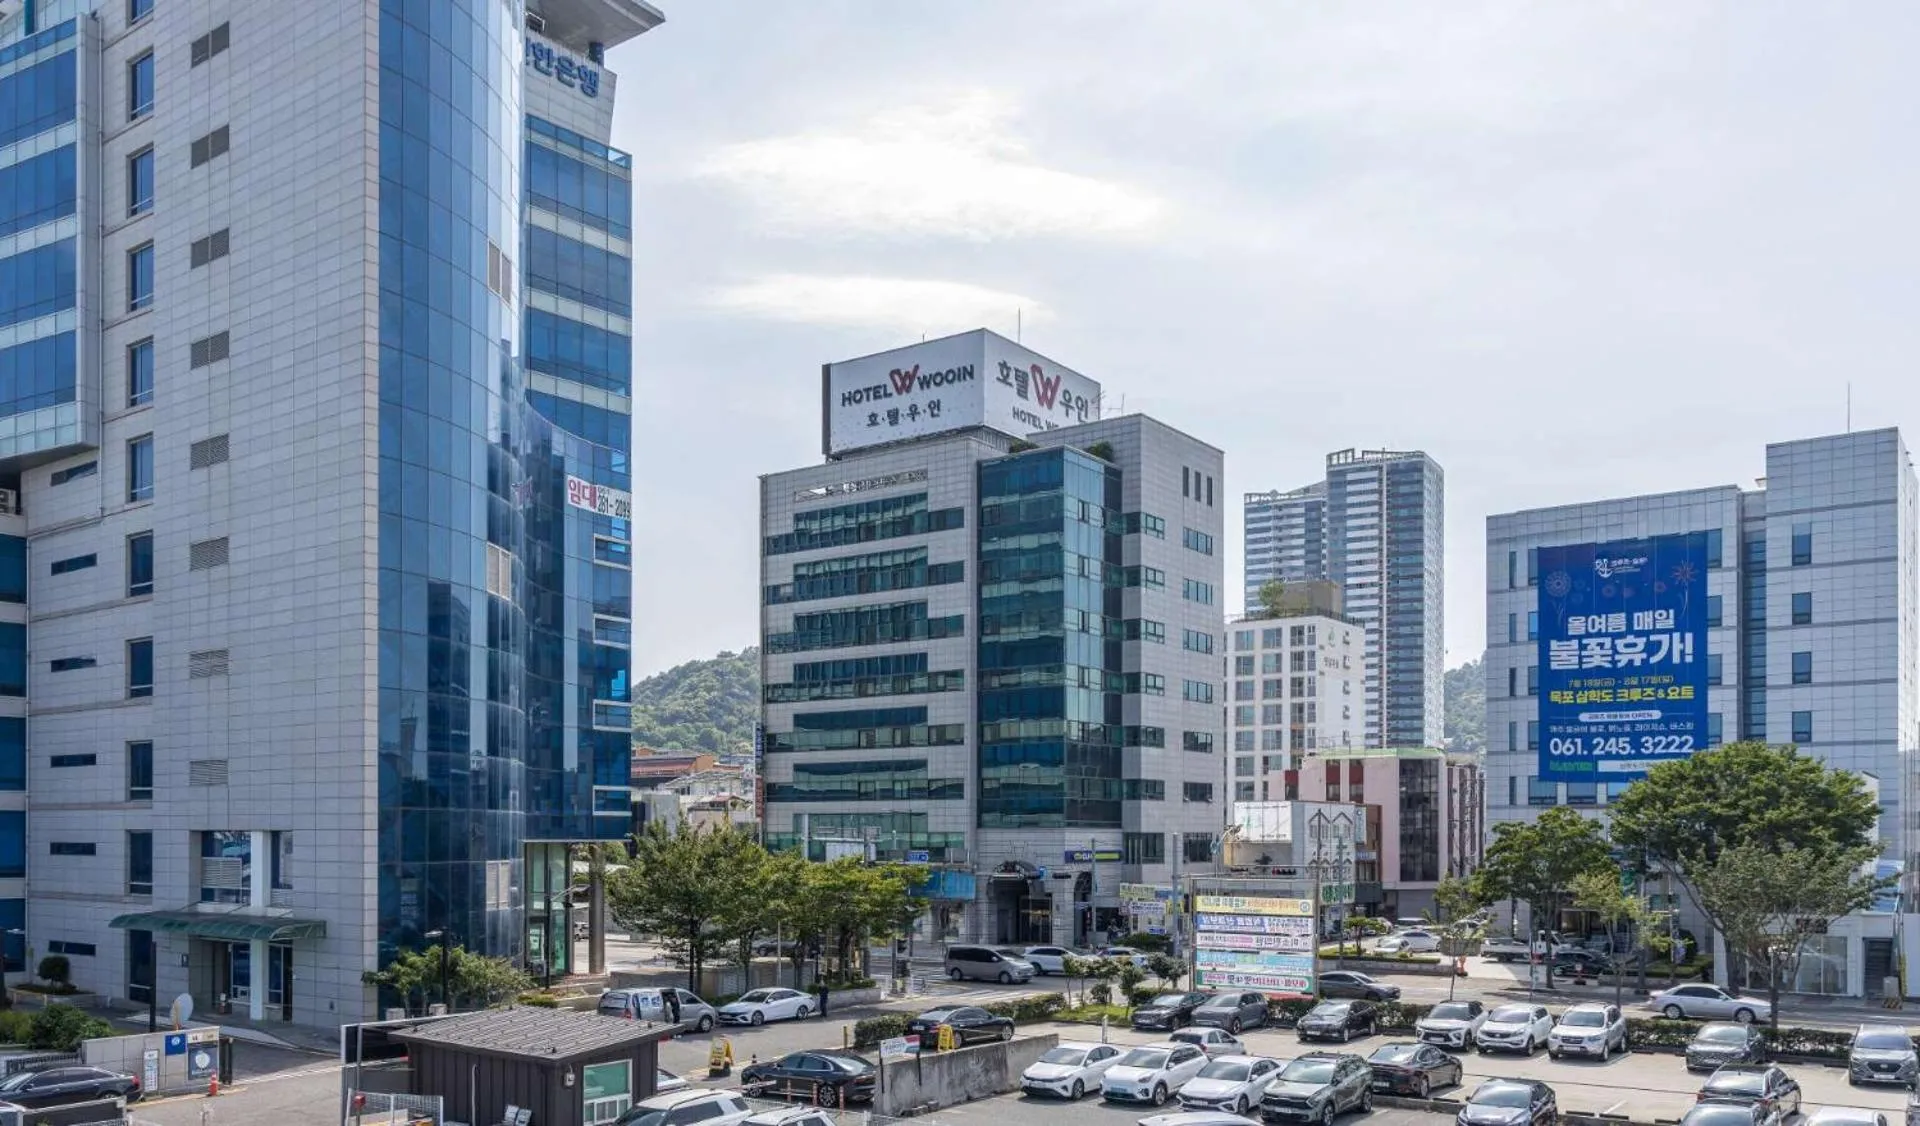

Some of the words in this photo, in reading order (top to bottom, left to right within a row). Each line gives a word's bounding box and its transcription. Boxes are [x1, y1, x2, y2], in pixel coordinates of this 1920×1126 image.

[841, 383, 893, 407] HOTEL
[917, 364, 975, 391] WOOIN
[996, 360, 1029, 401] 호텔
[1059, 388, 1089, 424] 우인
[1012, 406, 1044, 430] HOTEL
[569, 479, 597, 509] 임대
[1567, 612, 1627, 636] 올여름
[1633, 609, 1675, 631] 매일
[1549, 632, 1694, 671] 불꽃휴가!
[1550, 690, 1575, 705] 목포
[1576, 688, 1614, 704] 삼학도
[1666, 685, 1695, 701] 요트
[1549, 738, 1589, 756] 061.
[1592, 736, 1636, 756] 245.
[1640, 735, 1695, 755] 3222
